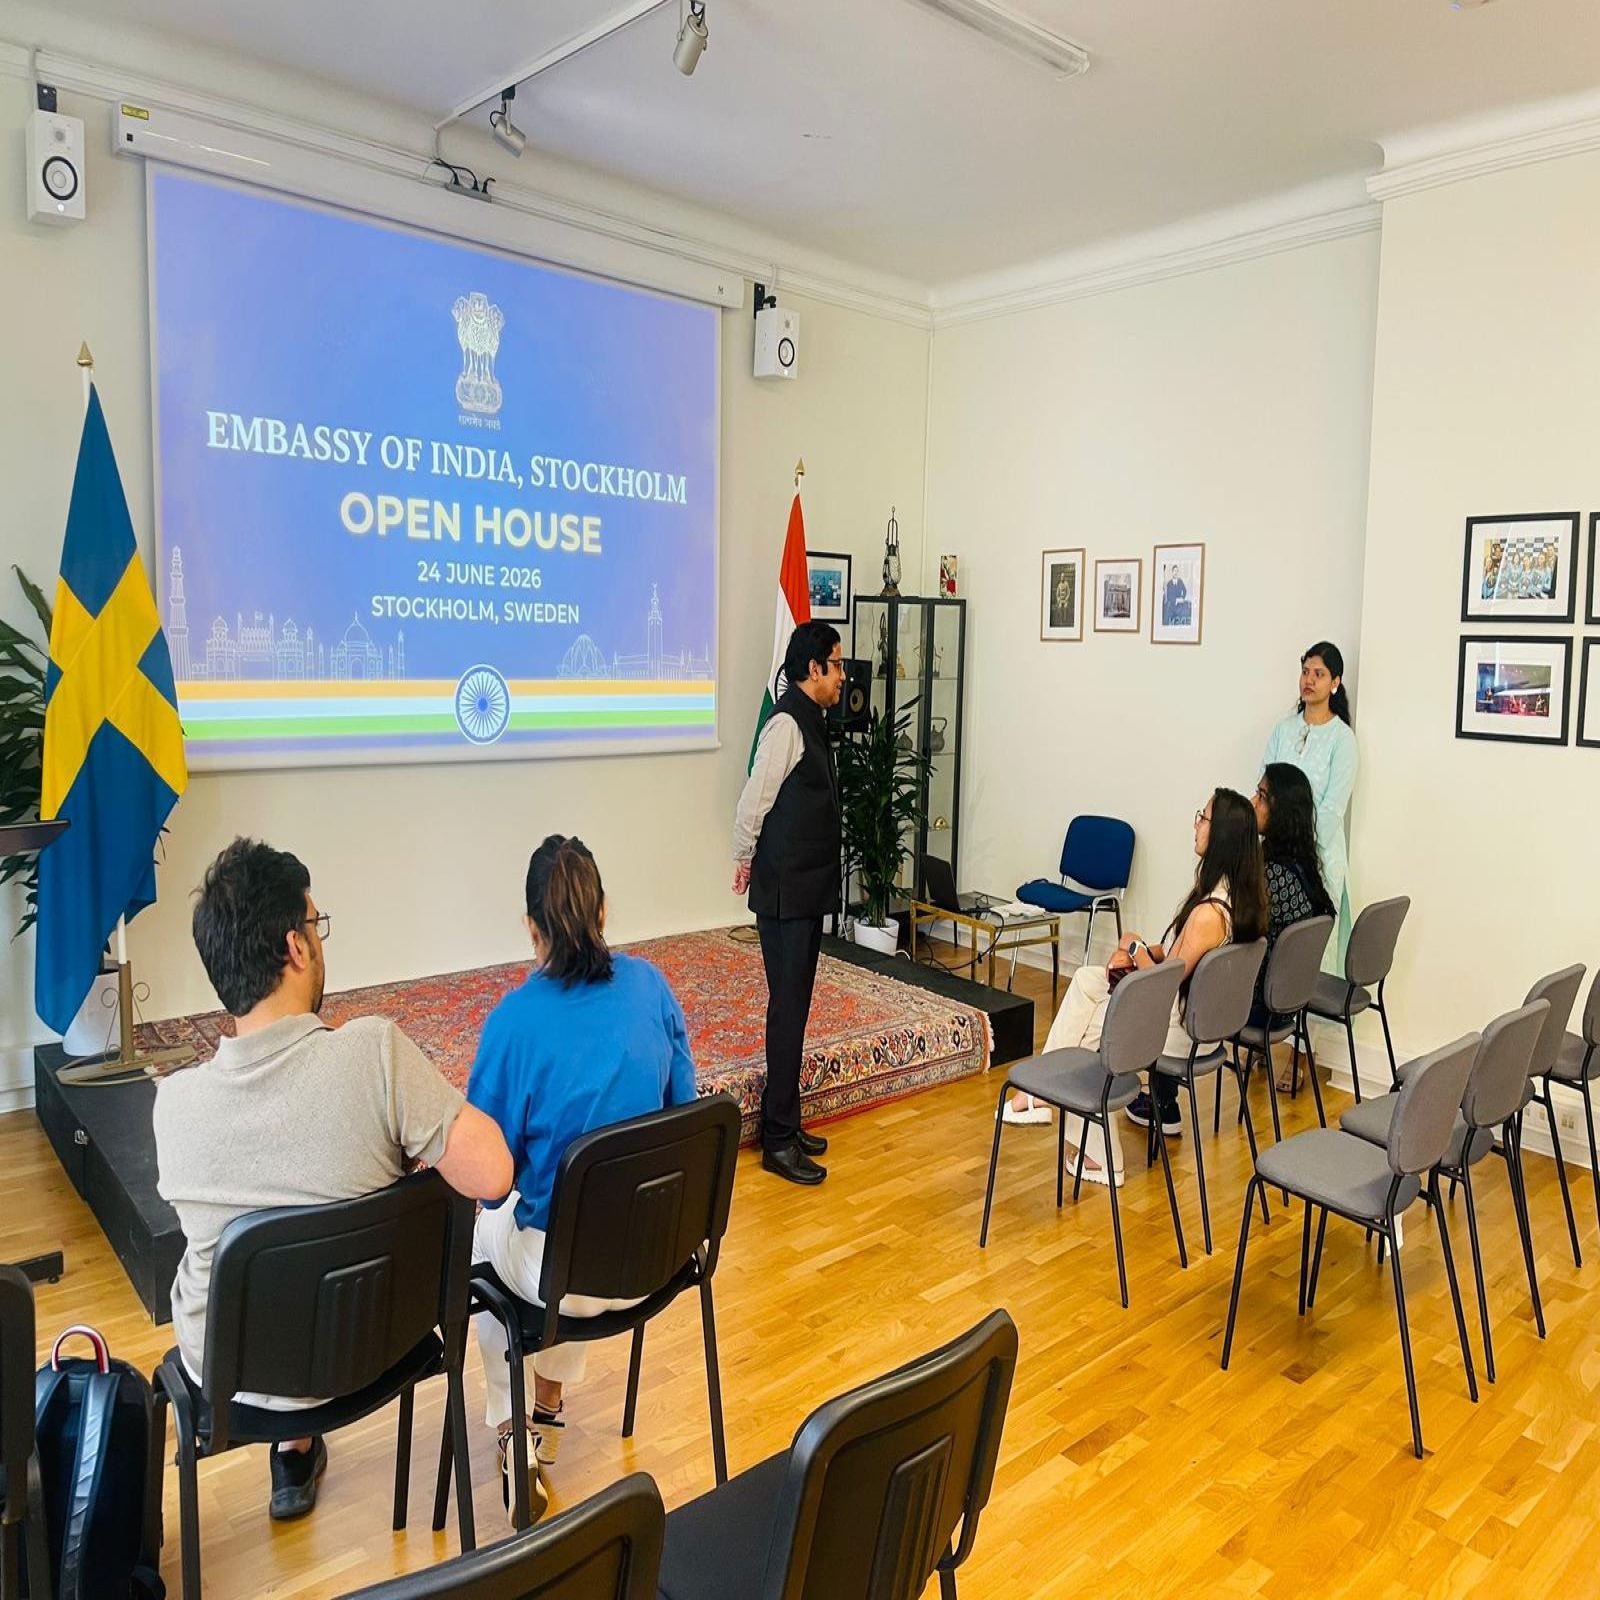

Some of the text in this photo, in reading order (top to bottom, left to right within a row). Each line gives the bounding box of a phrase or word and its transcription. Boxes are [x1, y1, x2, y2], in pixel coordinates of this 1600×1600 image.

[206, 411, 688, 504] EMBASSY OF INDIA, STOCKHOLM
[340, 491, 602, 553] OPEN HOUSE
[417, 561, 542, 588] 24 JUNE 2026
[371, 595, 580, 624] STOCKHOLM, SWEDEN
